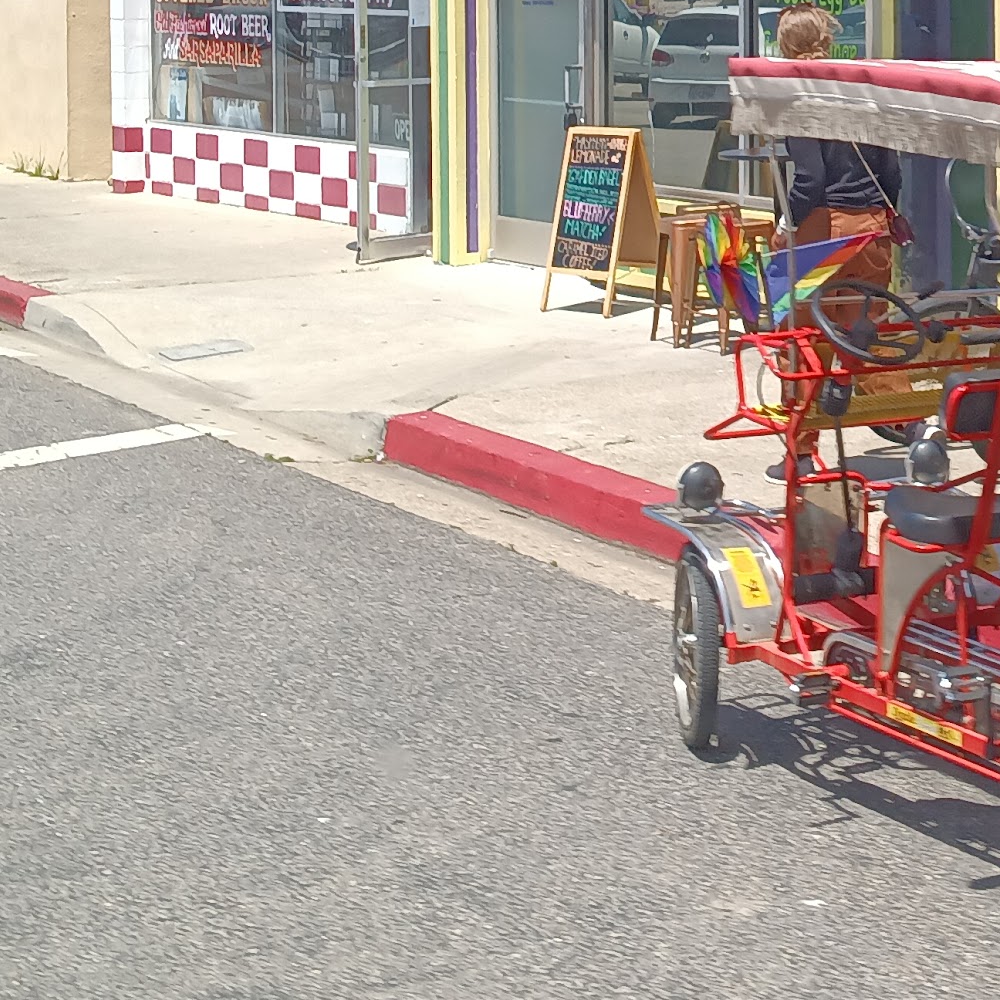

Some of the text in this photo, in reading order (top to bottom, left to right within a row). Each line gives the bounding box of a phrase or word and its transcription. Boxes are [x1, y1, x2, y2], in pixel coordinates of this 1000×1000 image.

[209, 12, 238, 38] ROOT
[241, 14, 271, 42] BEER
[179, 37, 262, 72] SARSAPARILLA
